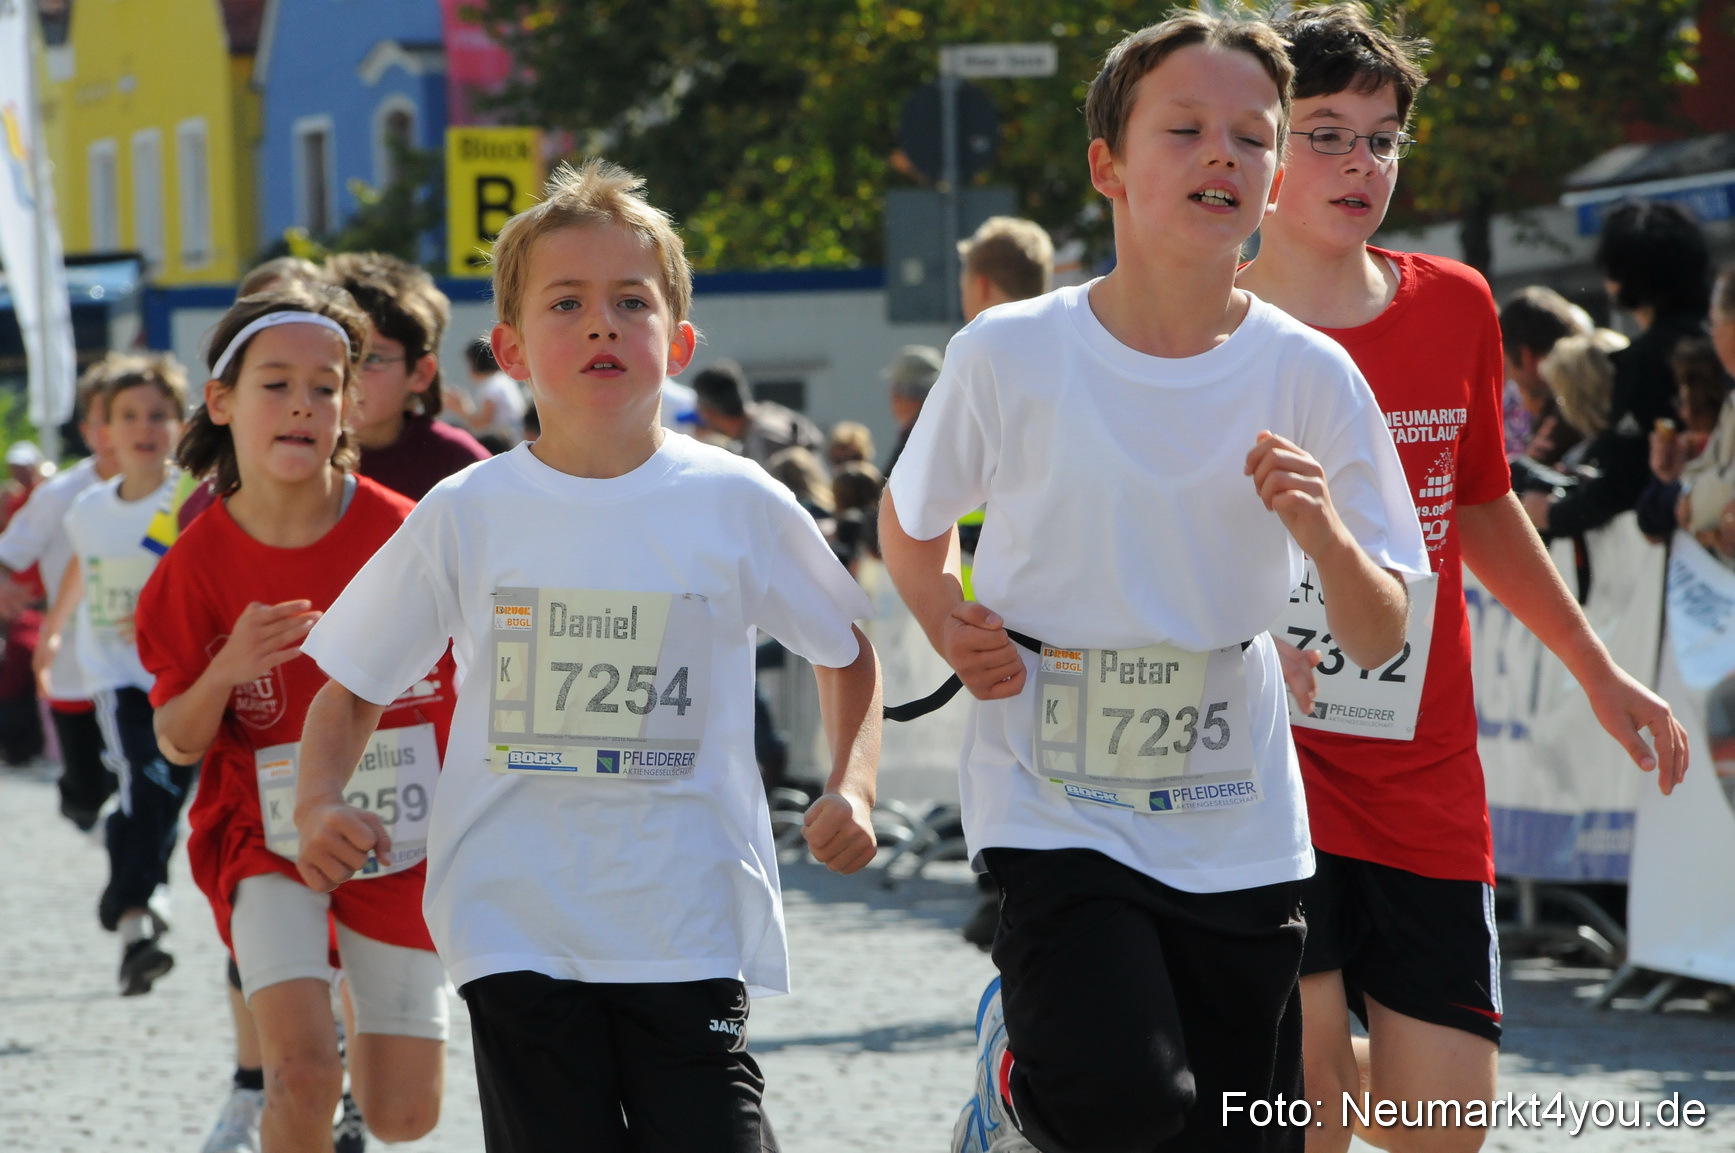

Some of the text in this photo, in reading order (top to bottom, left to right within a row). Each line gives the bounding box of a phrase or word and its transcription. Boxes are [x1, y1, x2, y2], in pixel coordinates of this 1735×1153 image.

[462, 138, 529, 161] Block
[476, 175, 517, 242] B
[1389, 425, 1459, 444] TADTLAUF
[549, 602, 638, 640] Daniel
[1287, 625, 1411, 682] 732
[500, 656, 511, 682] K
[1100, 650, 1179, 685] Petar
[550, 662, 692, 716] 7254
[1045, 699, 1058, 725] K
[1329, 704, 1395, 721] PFLEIDERER
[1102, 701, 1231, 757] 7235
[358, 743, 416, 772] elius
[508, 751, 562, 765] BOCK
[623, 750, 695, 767] PFLEIDERER
[1064, 784, 1119, 801] BOCK
[1172, 781, 1257, 802] PFLEIDERER
[709, 1019, 744, 1037] JAK
